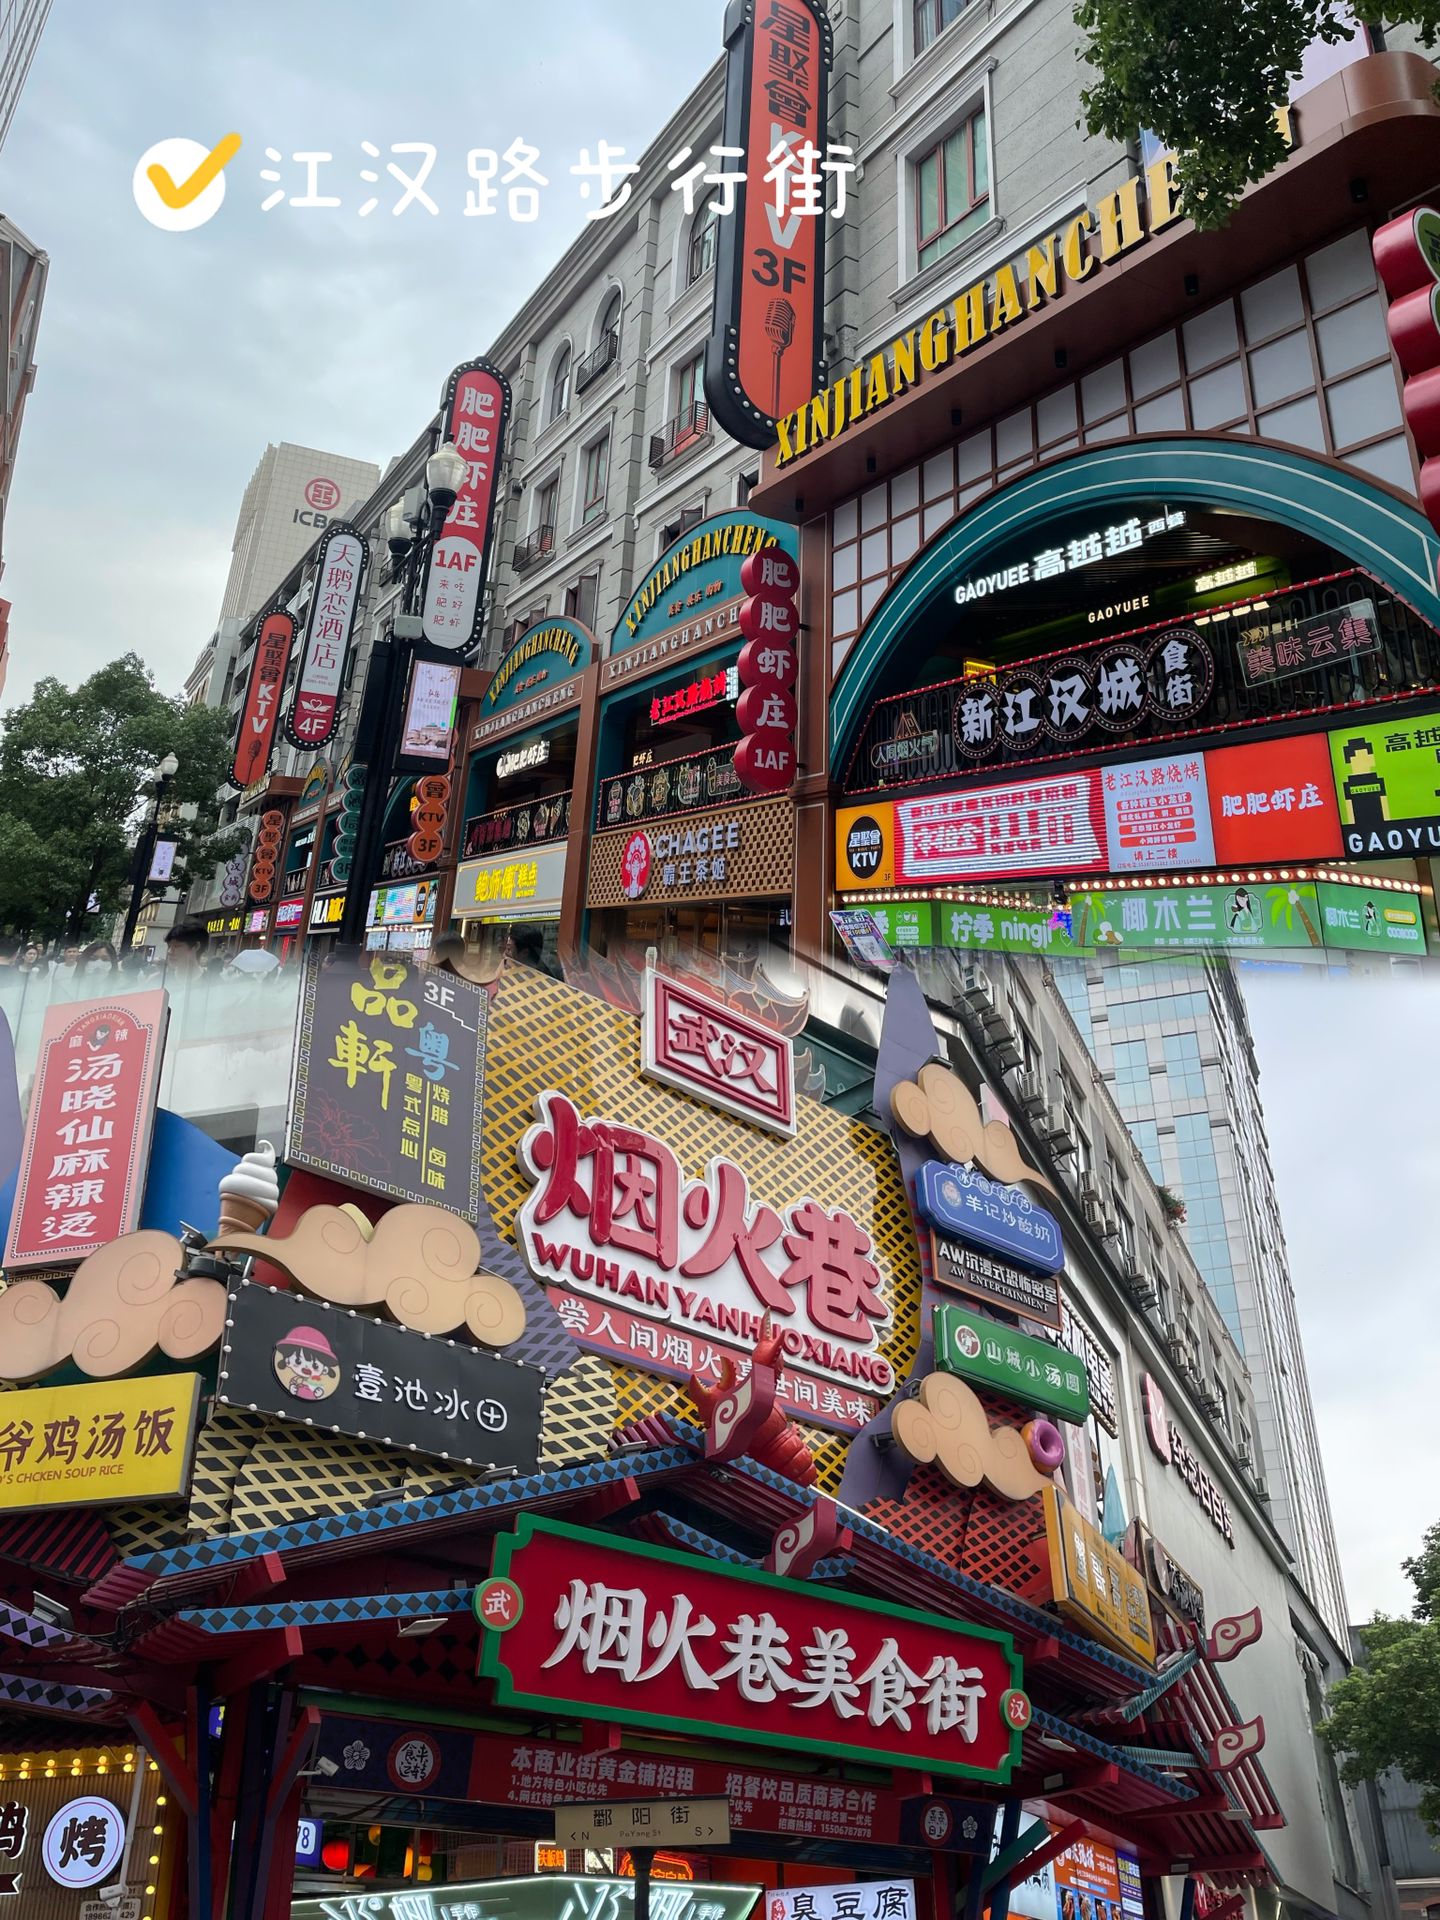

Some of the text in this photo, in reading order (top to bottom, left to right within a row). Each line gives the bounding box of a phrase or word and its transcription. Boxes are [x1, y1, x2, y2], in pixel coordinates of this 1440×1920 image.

[752, 248, 806, 294] 3F
[293, 509, 328, 529] ICB
[435, 550, 477, 572] 1AF
[955, 563, 1030, 604] GAOYUEE
[1033, 517, 1143, 581] 高越越
[311, 541, 356, 670] 天鹅恋酒店
[1088, 595, 1149, 623] GAOYUEE
[261, 632, 287, 682] 星聚會
[608, 608, 739, 679] XINJIANGHANCH
[757, 558, 792, 729] 肥肥虾庄
[1247, 616, 1372, 679] 美味云集
[489, 628, 578, 704] XINJIANGHANCHENG
[251, 683, 275, 734] KTV
[961, 639, 1193, 745] 新江汉城 食街
[299, 717, 327, 735] 4F
[754, 748, 789, 770] 1AF
[874, 736, 938, 765] 人间烟火气
[1104, 761, 1200, 791] 老江汉路烧烤
[418, 812, 444, 823] KTV
[1222, 782, 1324, 818] 肥肥虾庄
[418, 839, 437, 852] 3F
[655, 822, 740, 859] CHAGEE
[849, 830, 880, 847] 星聚會
[1134, 848, 1178, 861] 请上二楼
[1349, 826, 1440, 853] GAOYU
[255, 867, 273, 875] KTV
[663, 857, 726, 887] 霸王茶姬
[852, 851, 878, 868] KTV
[255, 884, 268, 893] 3F
[311, 898, 329, 924] HLA
[951, 912, 994, 944] 柠季
[1121, 895, 1217, 932] 椰木兰
[423, 980, 456, 1007] 3F
[669, 1012, 777, 1096] 武汉
[401, 1072, 422, 1162] 粤式点心
[39, 1051, 124, 1242] 汤晓仙麻辣烫
[531, 1096, 889, 1343] 烟火巷
[965, 1194, 1051, 1244] 羊记炒酸奶
[531, 1232, 669, 1308] WUHAN
[951, 1265, 1049, 1313] AW ENTERTAINMENT
[353, 1362, 509, 1433] 壹池冰田
[0, 1406, 176, 1472] 爷鸡汤饭
[16, 1470, 62, 1484] CHCKEN
[65, 1466, 96, 1479] SOUP
[100, 1464, 125, 1476] RICE
[484, 1578, 1028, 1744] 武 烟火巷美食街 汉
[511, 1746, 694, 1791] 本商业街黄金铺招租
[511, 1775, 608, 1797] 1.地方特色小吃优先
[725, 1773, 877, 1813] 招餐饮品质商家合作
[593, 1806, 690, 1827] 鄱阳街
[694, 1826, 703, 1837] S
[59, 1816, 109, 1869] 烤
[581, 1831, 590, 1841] N
[619, 1830, 651, 1839] PoYang
[791, 1886, 909, 1920] 臭豆腐
